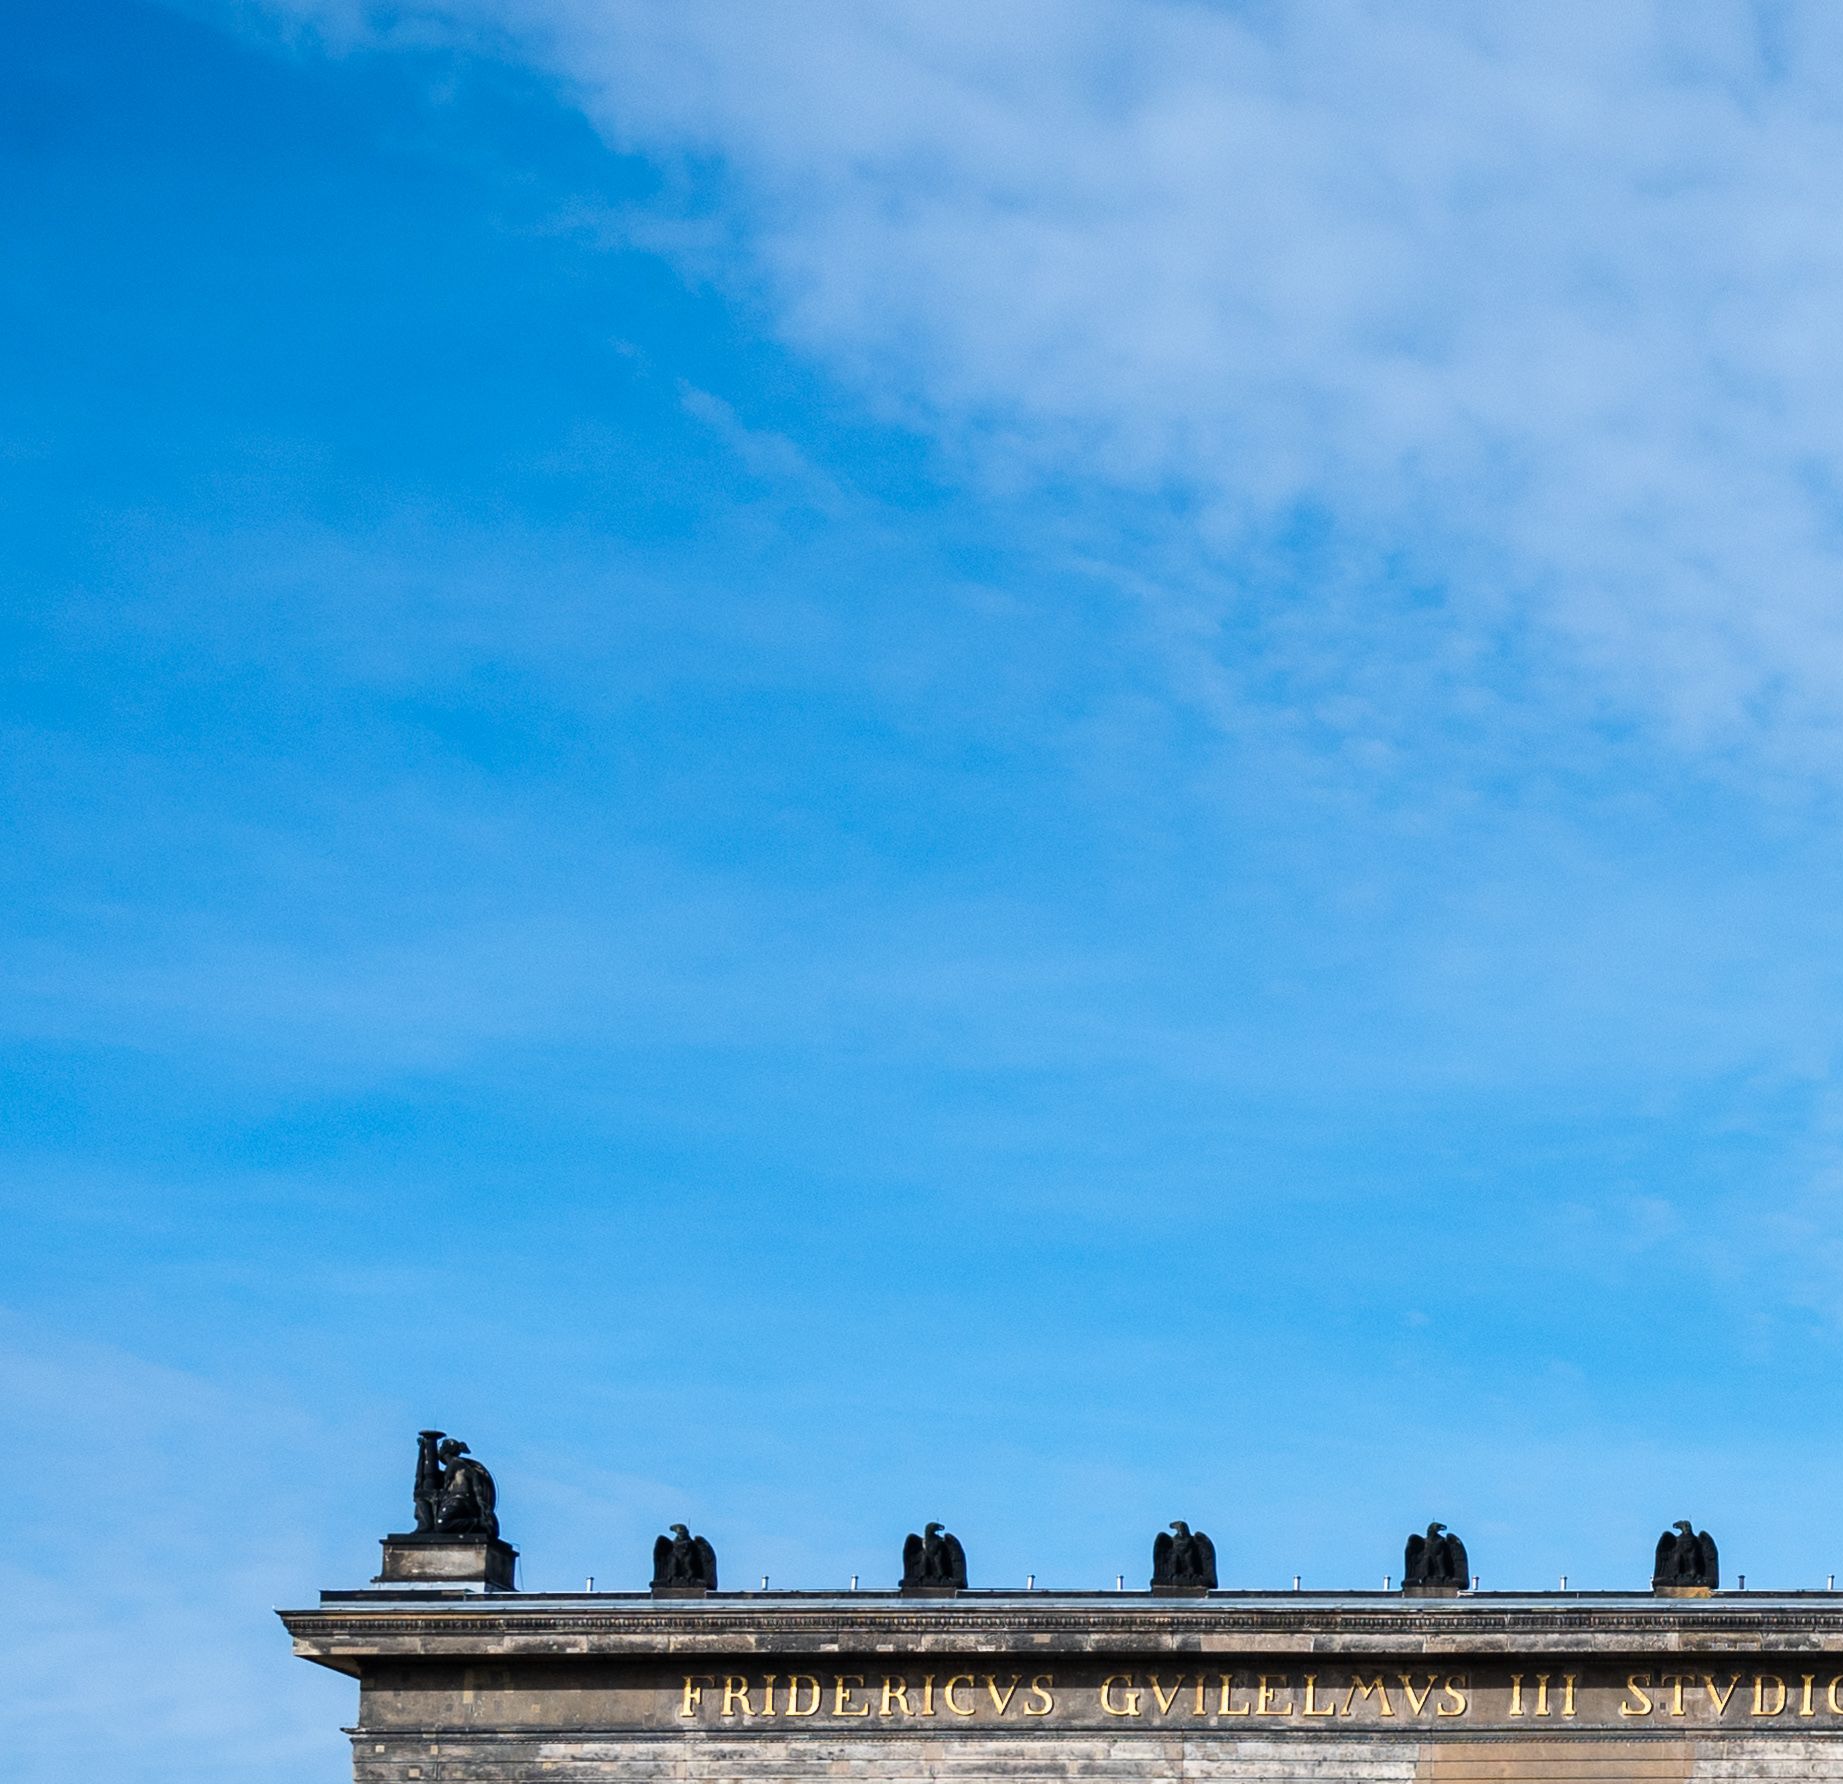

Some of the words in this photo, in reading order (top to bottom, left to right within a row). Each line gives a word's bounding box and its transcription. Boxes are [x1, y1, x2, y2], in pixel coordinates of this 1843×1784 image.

[681, 1675, 1054, 1717] FRIDERICVS
[1099, 1675, 1467, 1717] GVILELMVS
[1510, 1675, 1578, 1717] III
